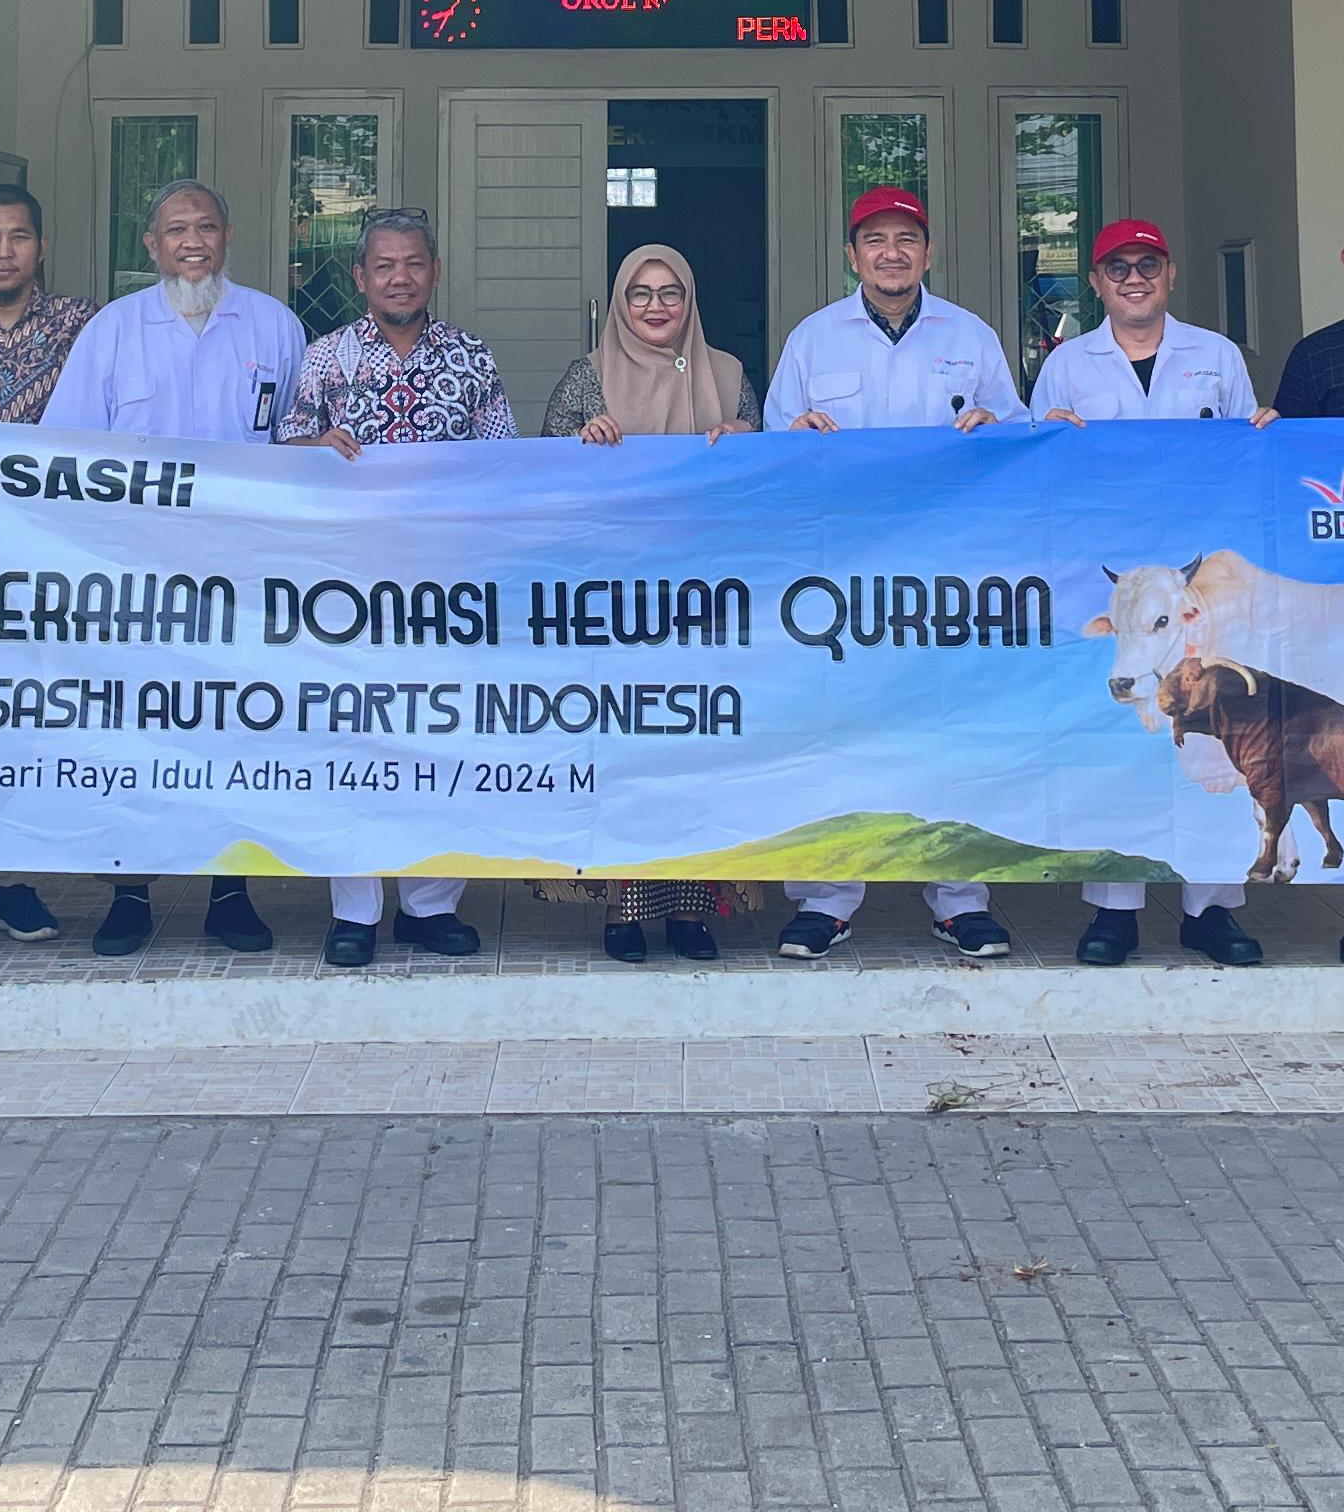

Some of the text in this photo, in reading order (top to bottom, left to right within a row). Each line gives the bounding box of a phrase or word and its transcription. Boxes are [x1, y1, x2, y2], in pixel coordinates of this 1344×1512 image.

[263, 577, 500, 646] DONASI
[528, 578, 751, 647] HEWAN
[780, 575, 1053, 662] QURBAN
[137, 680, 284, 732] AUTO
[297, 681, 461, 734] PARTS
[474, 683, 742, 737] INDONESIA
[56, 758, 138, 797] Raya
[151, 760, 215, 791] Idul
[226, 760, 312, 792] Adha
[325, 761, 400, 793] 1445
[414, 763, 435, 793] H
[474, 764, 555, 794] 2024
[569, 764, 595, 794] M
